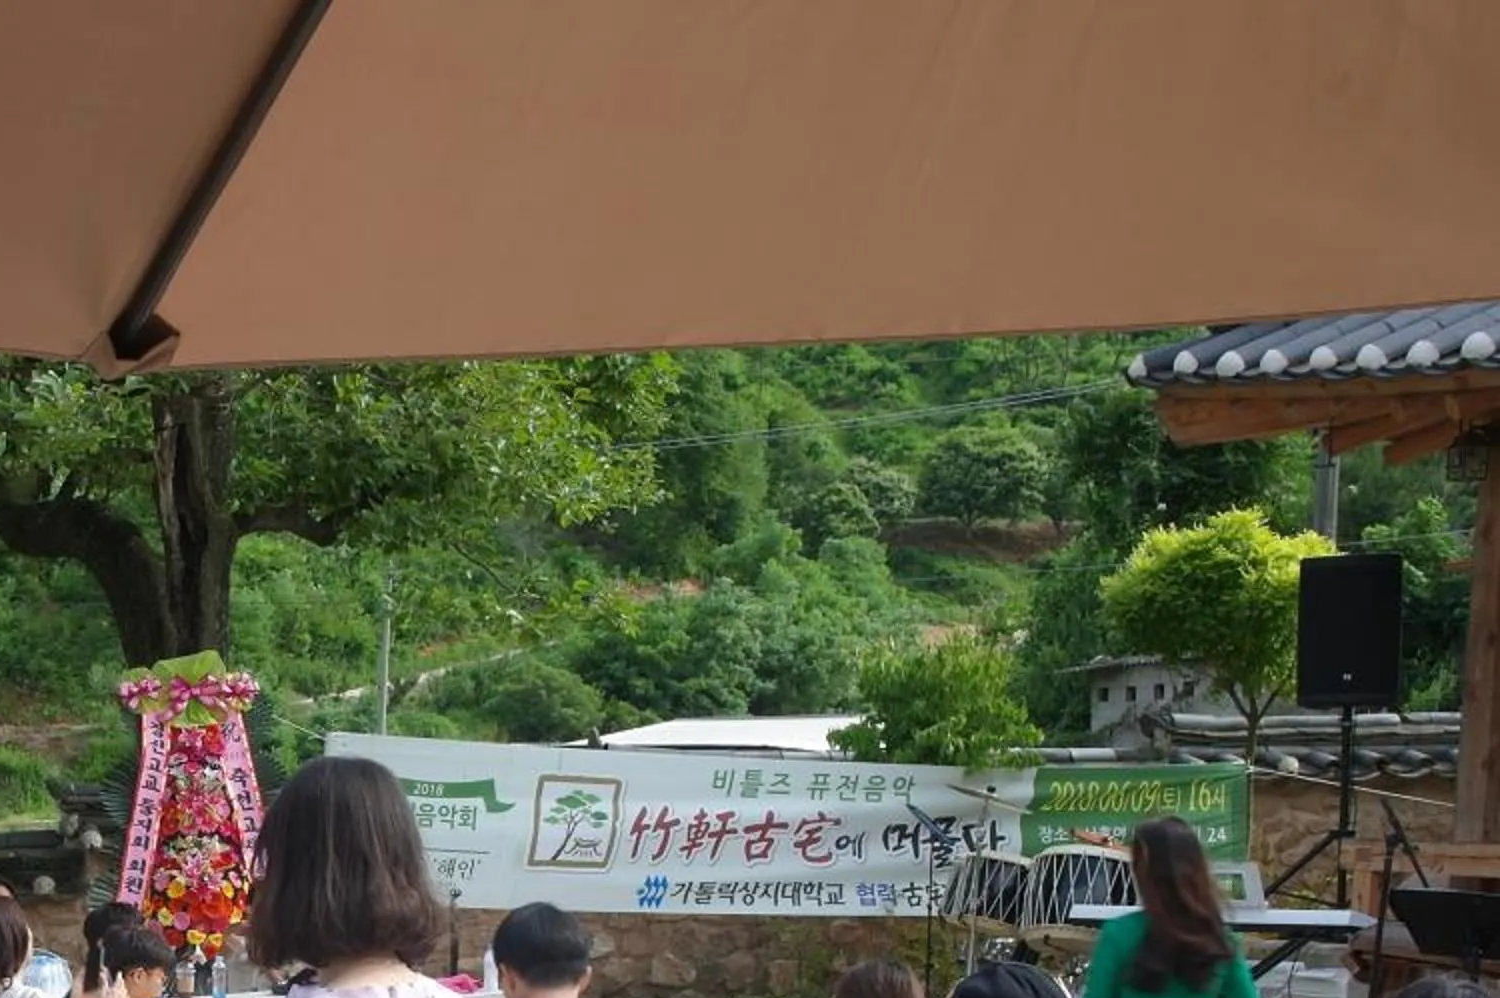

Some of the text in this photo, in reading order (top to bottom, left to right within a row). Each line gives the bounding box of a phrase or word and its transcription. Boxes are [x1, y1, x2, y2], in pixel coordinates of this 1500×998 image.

[413, 783, 444, 796] 2018
[711, 768, 917, 802] 비틀즈 퓨전음악
[1187, 778, 1226, 813] 16시
[411, 802, 478, 831] 음악회
[882, 815, 1007, 869] 머물다
[1206, 827, 1227, 843] 24
[670, 879, 844, 907] 가톨릭상지대학교
